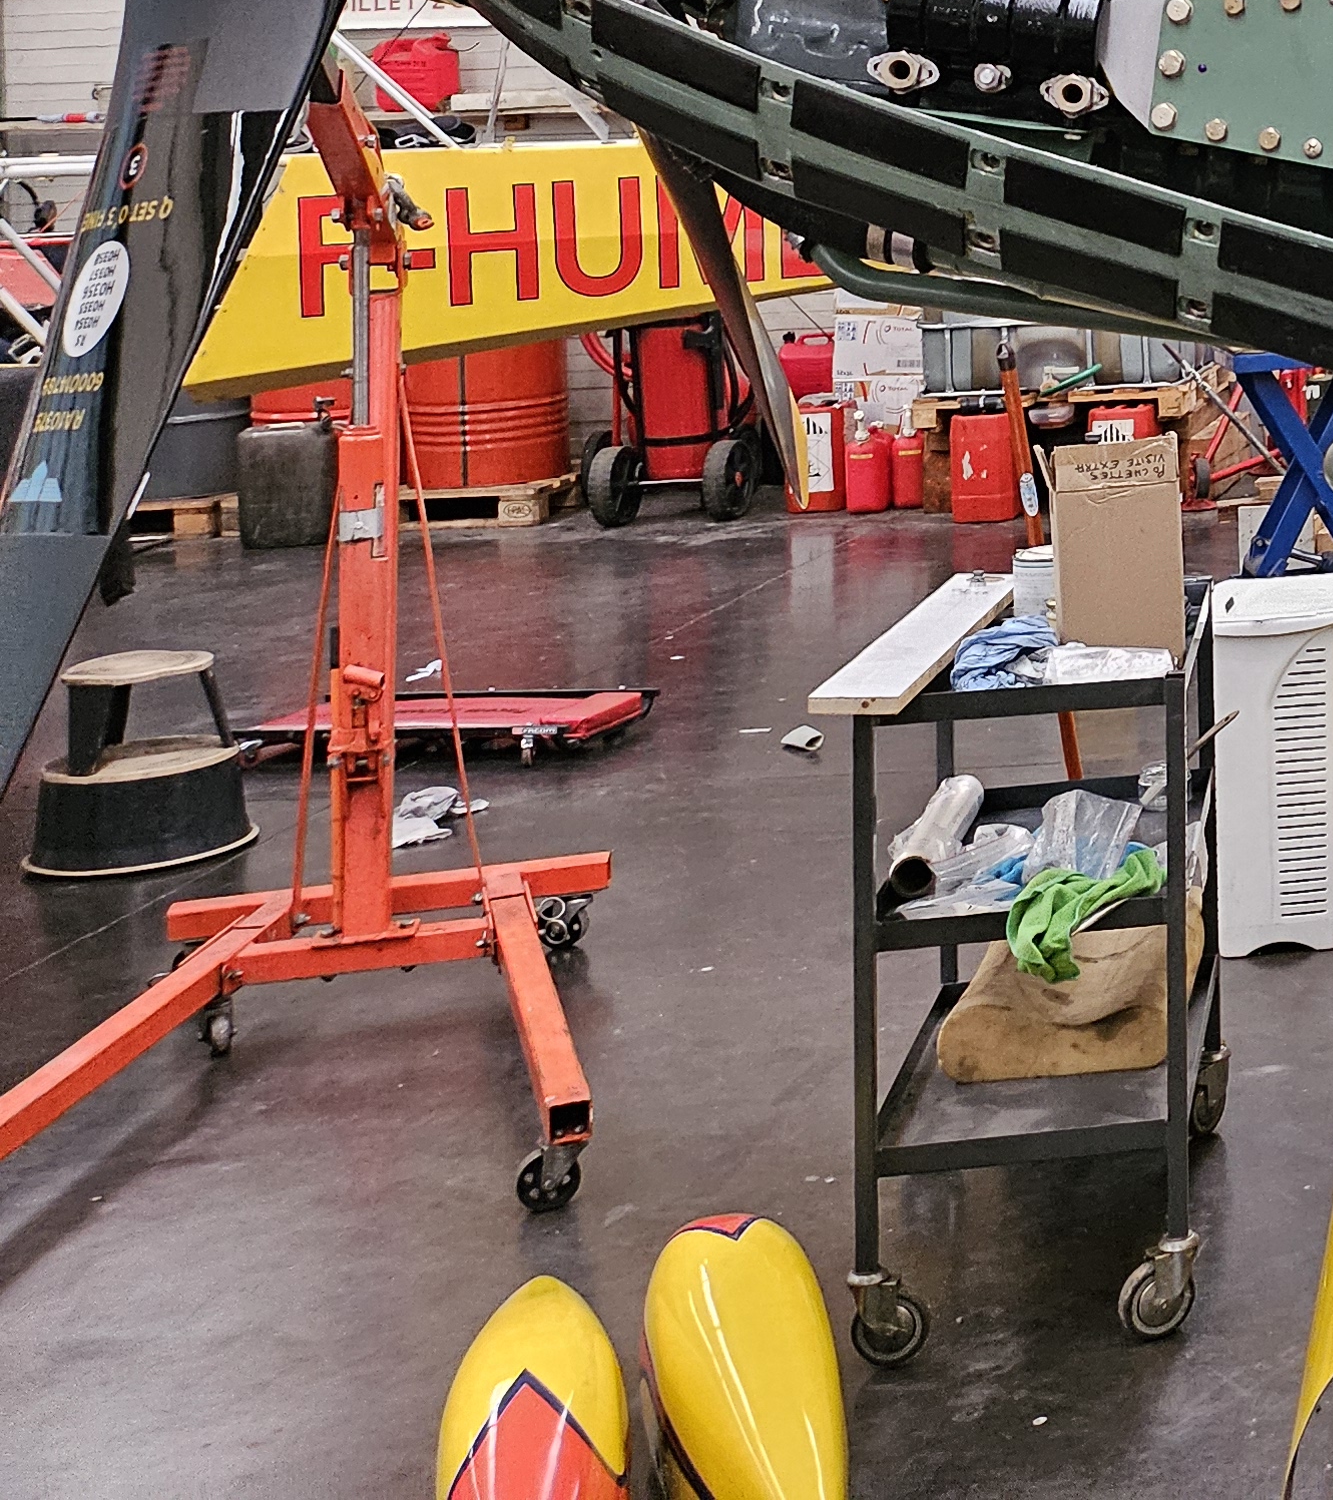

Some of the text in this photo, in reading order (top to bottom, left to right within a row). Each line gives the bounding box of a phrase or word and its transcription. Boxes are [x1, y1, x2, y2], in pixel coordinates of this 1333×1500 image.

[128, 155, 141, 176] 3
[128, 199, 159, 223] SET
[1074, 453, 1165, 473] VISITE EXTRA
